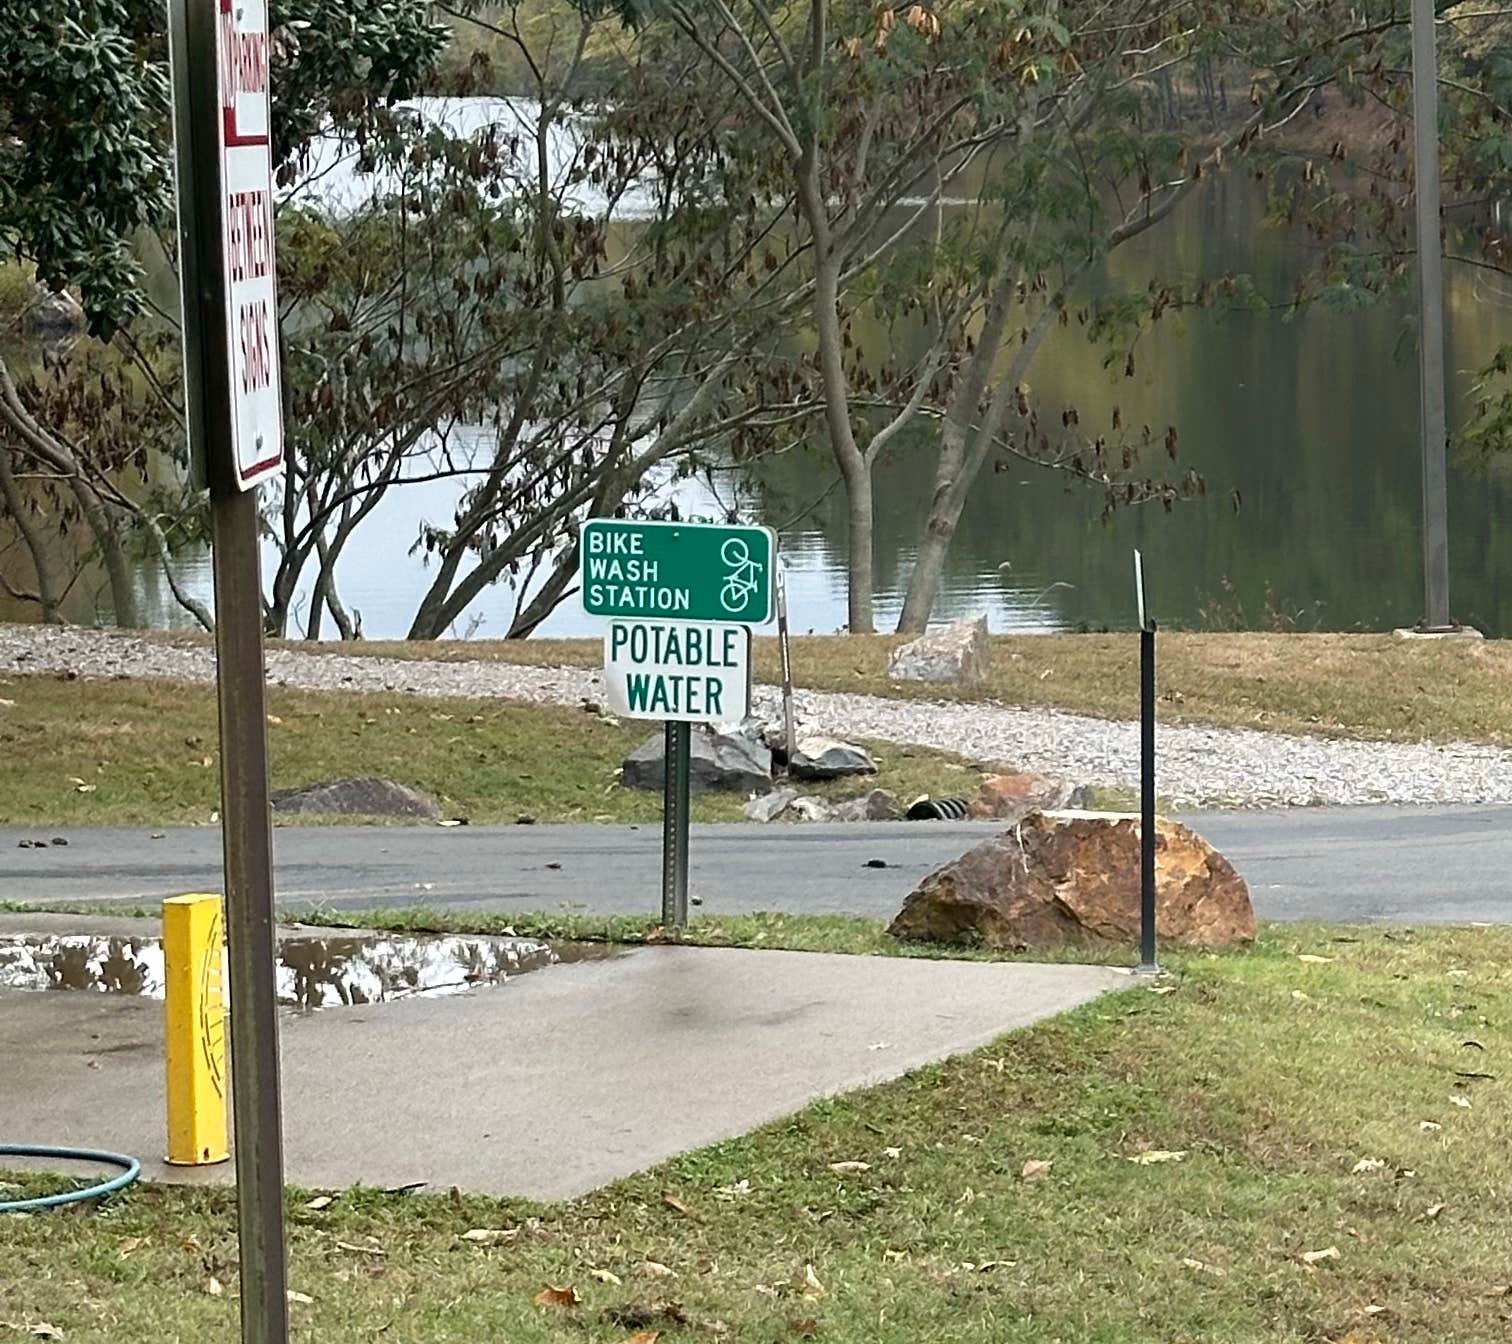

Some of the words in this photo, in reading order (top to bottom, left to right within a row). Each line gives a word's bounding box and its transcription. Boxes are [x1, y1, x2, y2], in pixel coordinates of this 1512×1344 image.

[230, 191, 270, 281] BETWEEN
[240, 300, 270, 394] SIGNS
[589, 531, 643, 555] BIKE
[589, 557, 658, 582] WASH
[589, 584, 690, 610] STATION
[611, 624, 738, 667] POTABLE
[626, 673, 723, 715] WATER
